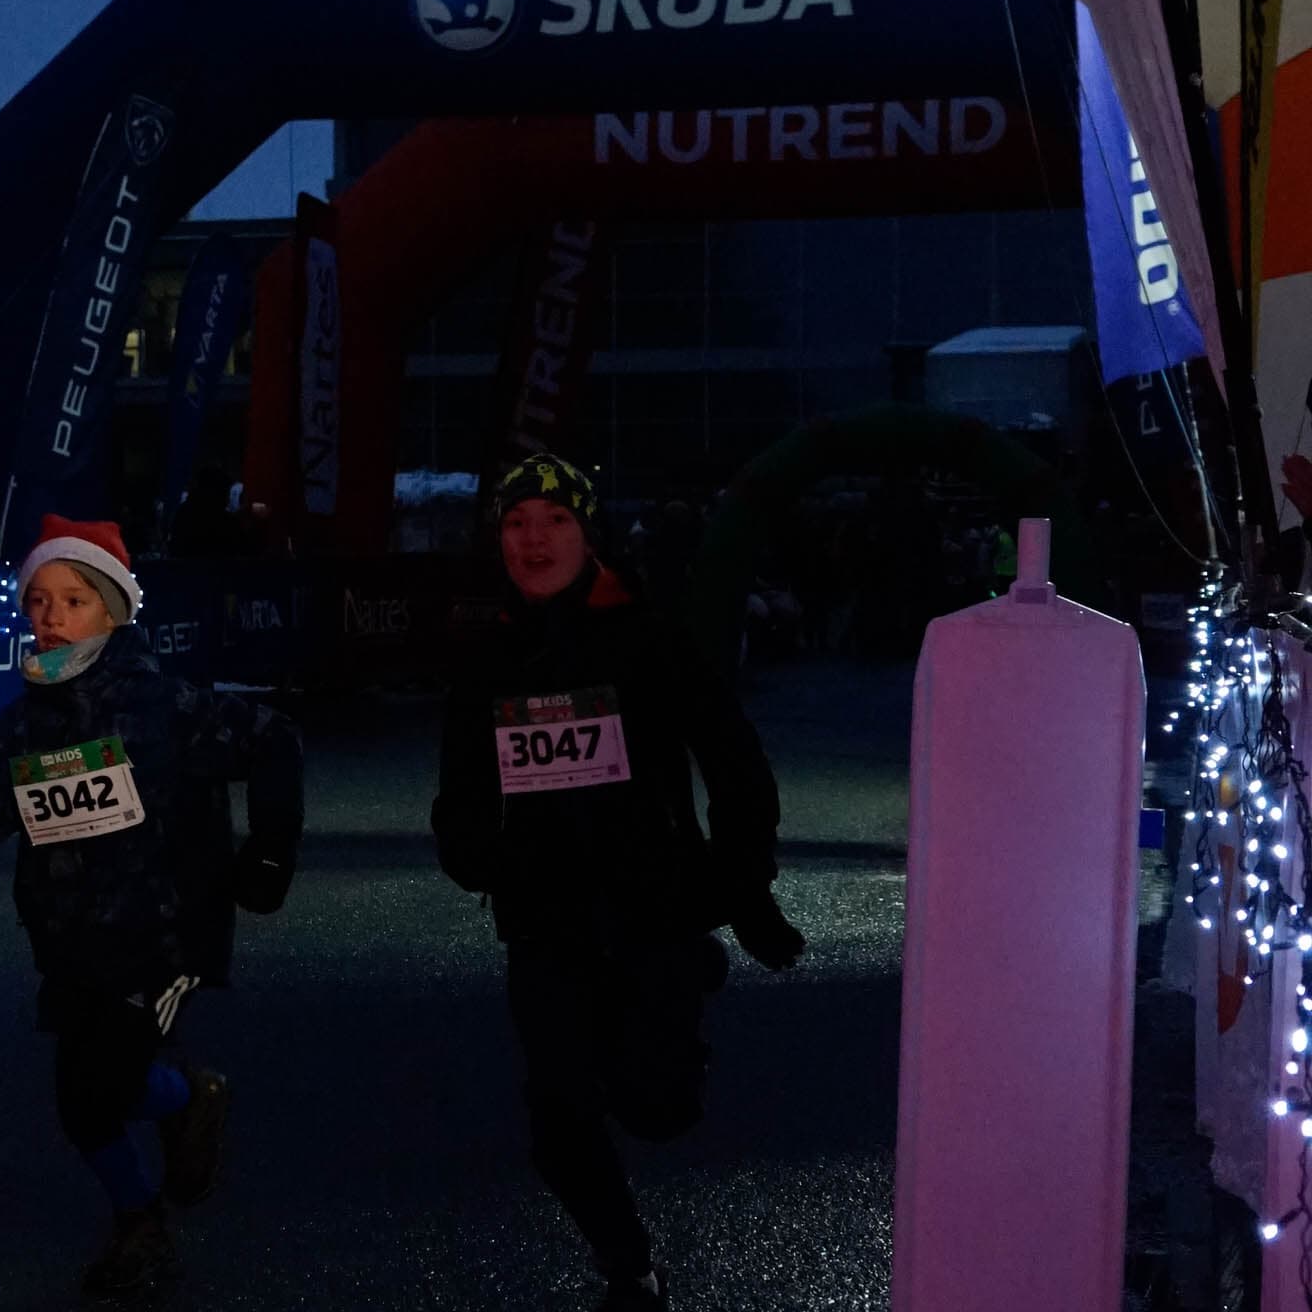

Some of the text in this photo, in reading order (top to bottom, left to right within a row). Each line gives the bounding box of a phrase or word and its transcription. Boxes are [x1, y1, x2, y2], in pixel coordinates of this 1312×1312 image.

[593, 95, 1007, 166] NUTREND
[49, 175, 142, 459] PEUGEOT
[54, 748, 84, 764] KIDS
[508, 724, 602, 768] 3047
[26, 775, 120, 822] 3042
